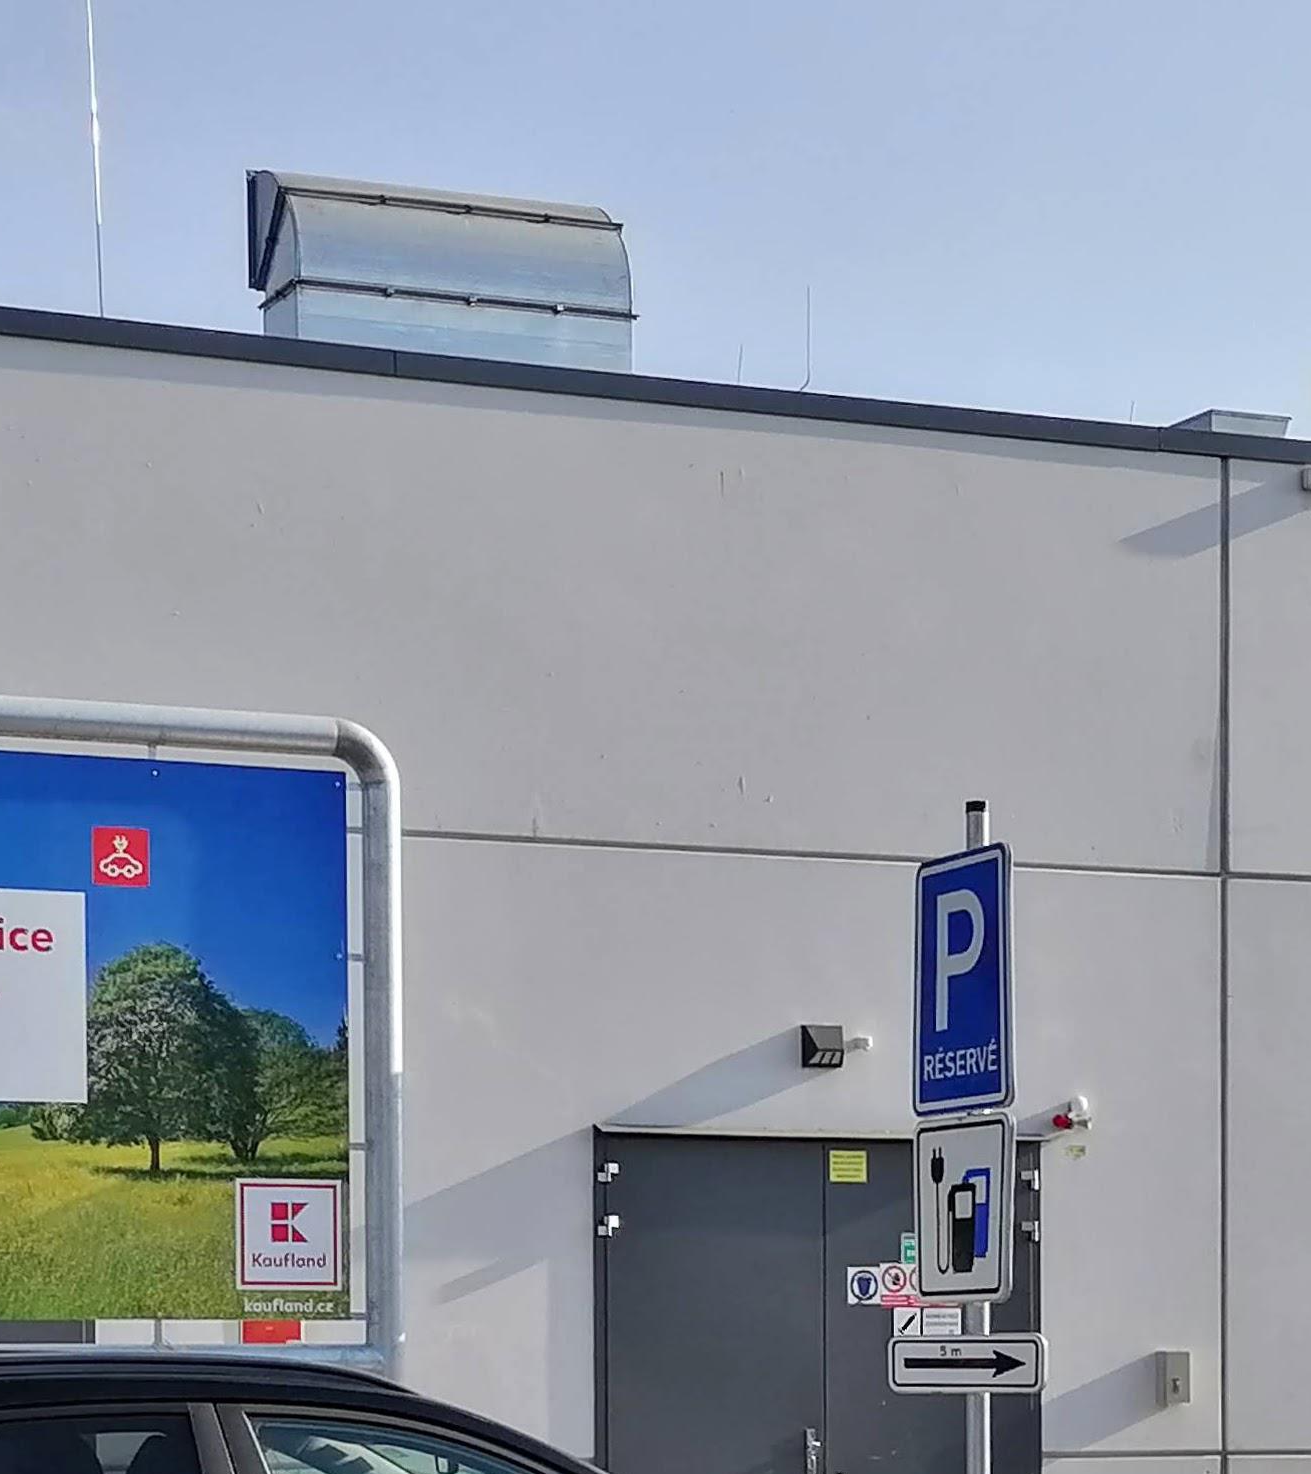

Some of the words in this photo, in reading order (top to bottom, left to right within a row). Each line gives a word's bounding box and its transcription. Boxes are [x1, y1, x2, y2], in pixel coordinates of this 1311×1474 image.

[936, 888, 985, 1032] P
[923, 1038, 998, 1082] RÉSERVÉ
[251, 1253, 327, 1269] Kaufland
[244, 1298, 335, 1313] kaufland.cz
[950, 1347, 962, 1357] m
